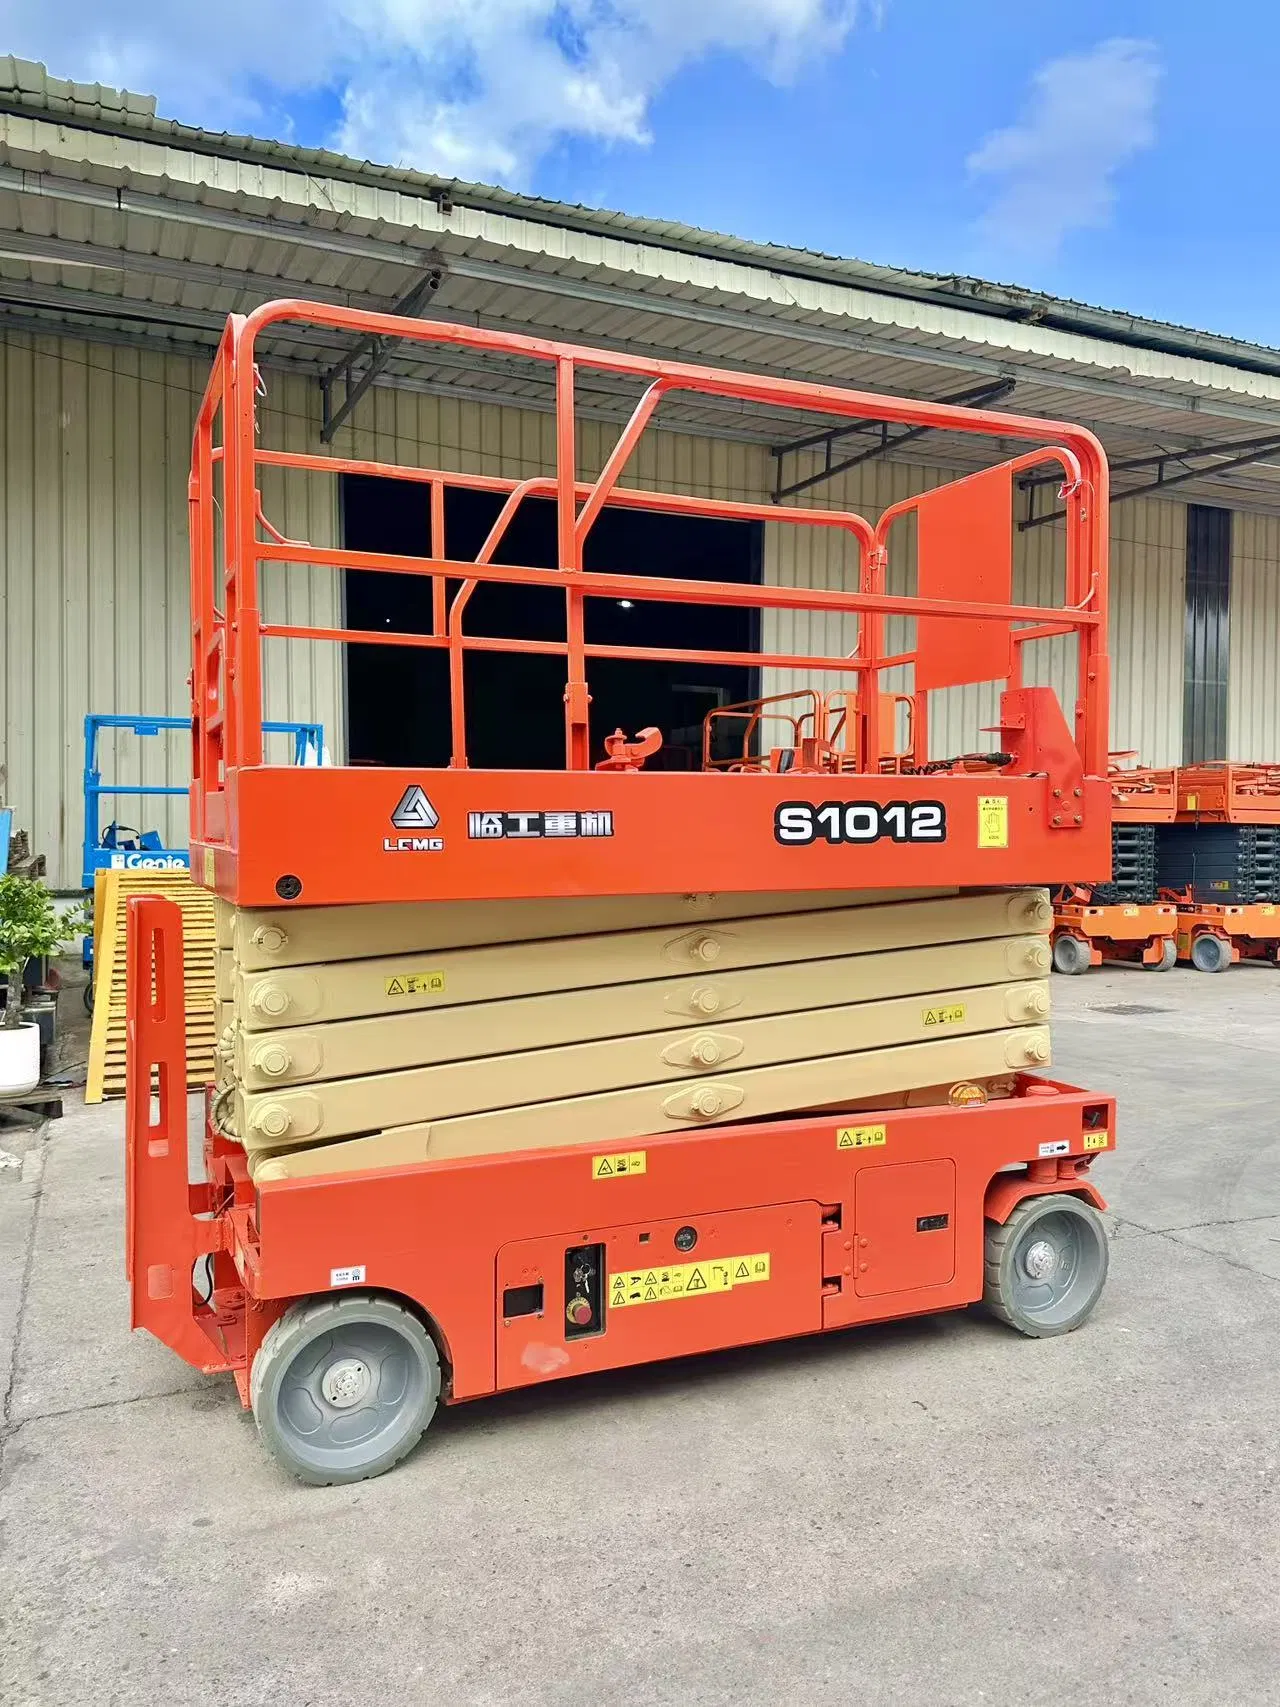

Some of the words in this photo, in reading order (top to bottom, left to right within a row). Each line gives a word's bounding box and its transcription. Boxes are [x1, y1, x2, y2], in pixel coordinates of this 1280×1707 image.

[468, 811, 614, 839] 临工重机
[779, 806, 942, 840] S1012
[127, 853, 185, 869] Genie
